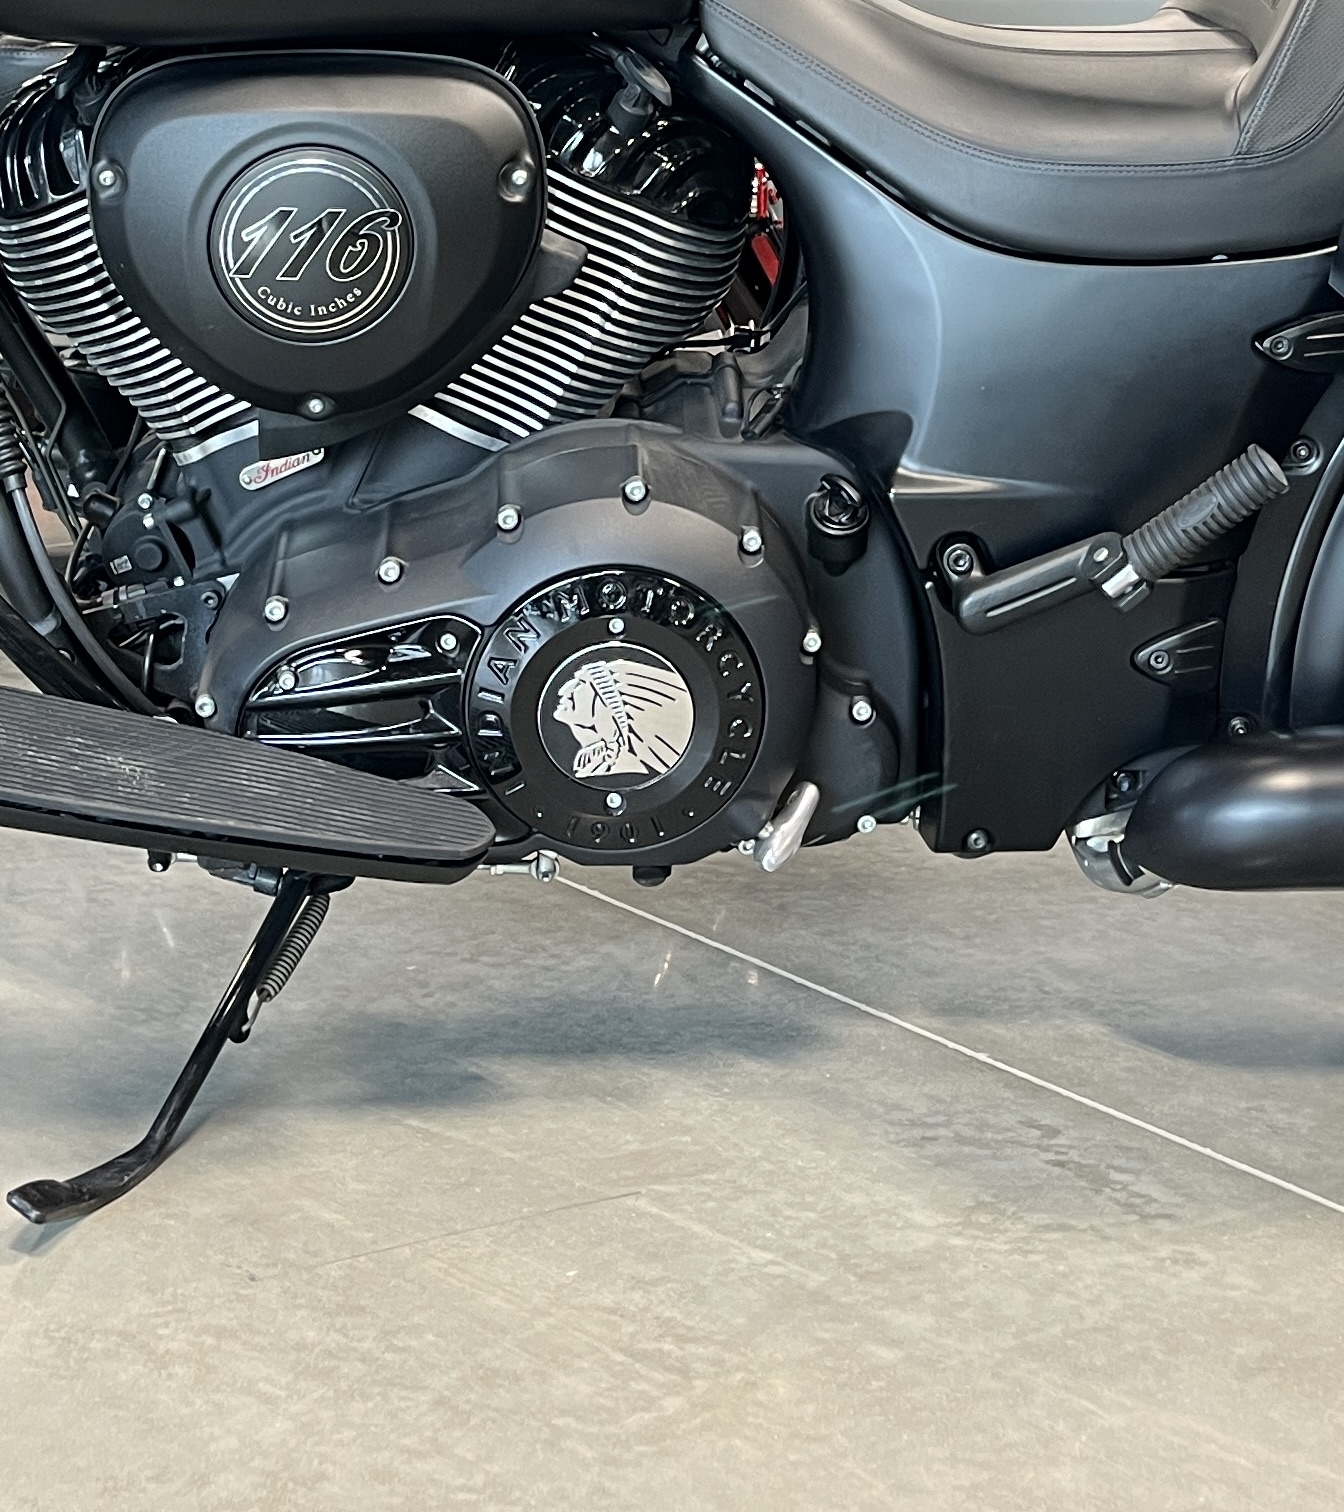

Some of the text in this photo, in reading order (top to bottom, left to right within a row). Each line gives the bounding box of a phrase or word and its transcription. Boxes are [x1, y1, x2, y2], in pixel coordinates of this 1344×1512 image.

[229, 206, 403, 282] 116
[257, 286, 363, 317] Cubic Inches
[253, 452, 311, 484] Indian
[475, 578, 755, 796] INDIAN MOTORCYCLE
[566, 816, 665, 844] 1901
